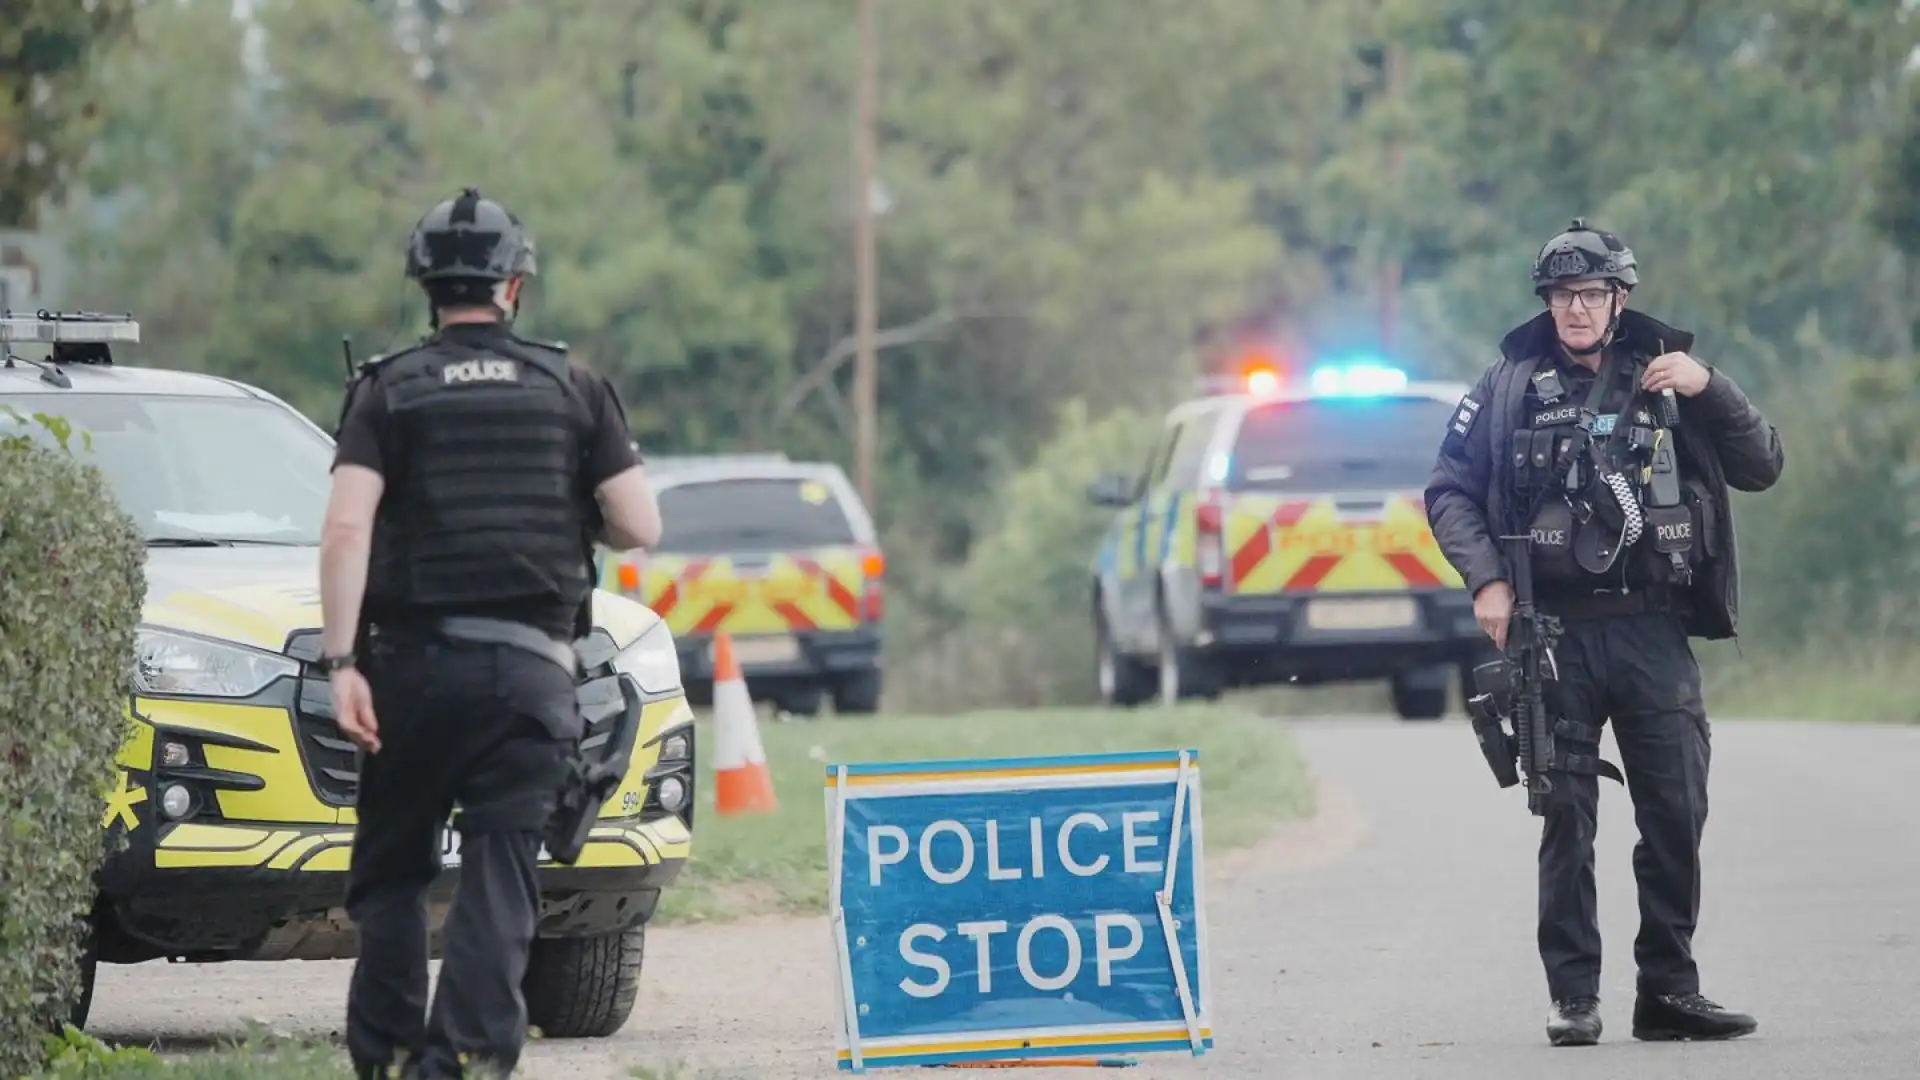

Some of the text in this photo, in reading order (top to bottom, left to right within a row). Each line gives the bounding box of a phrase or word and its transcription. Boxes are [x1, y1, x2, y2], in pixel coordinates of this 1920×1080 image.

[444, 360, 518, 384] POLICE
[1535, 407, 1577, 425] POLICE
[1530, 528, 1566, 546] POLICE
[1657, 522, 1692, 541] POLICE
[867, 811, 1164, 887] POLICE
[899, 913, 1145, 998] STOP
